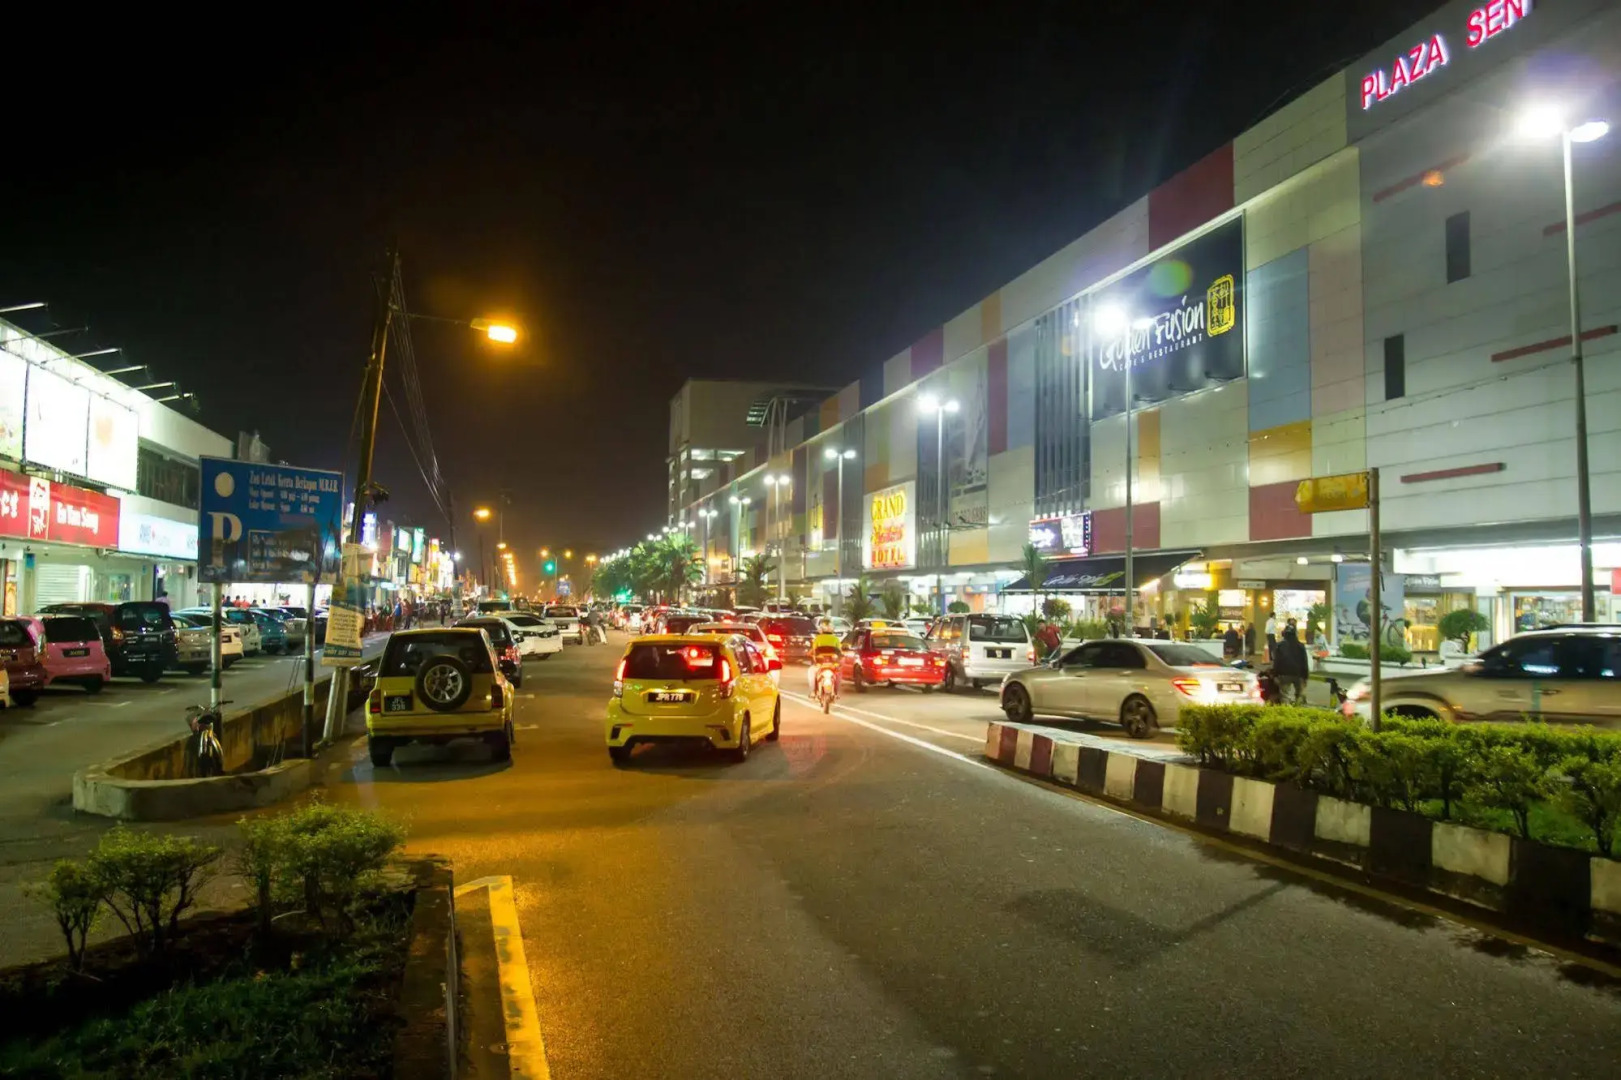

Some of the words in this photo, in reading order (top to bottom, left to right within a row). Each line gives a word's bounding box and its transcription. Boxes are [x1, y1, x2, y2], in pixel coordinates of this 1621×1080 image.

[1361, 34, 1449, 110] PLAZA
[1466, 0, 1530, 48] SEN
[1148, 333, 1202, 360] RESTAURANT
[871, 490, 907, 520] GRAND
